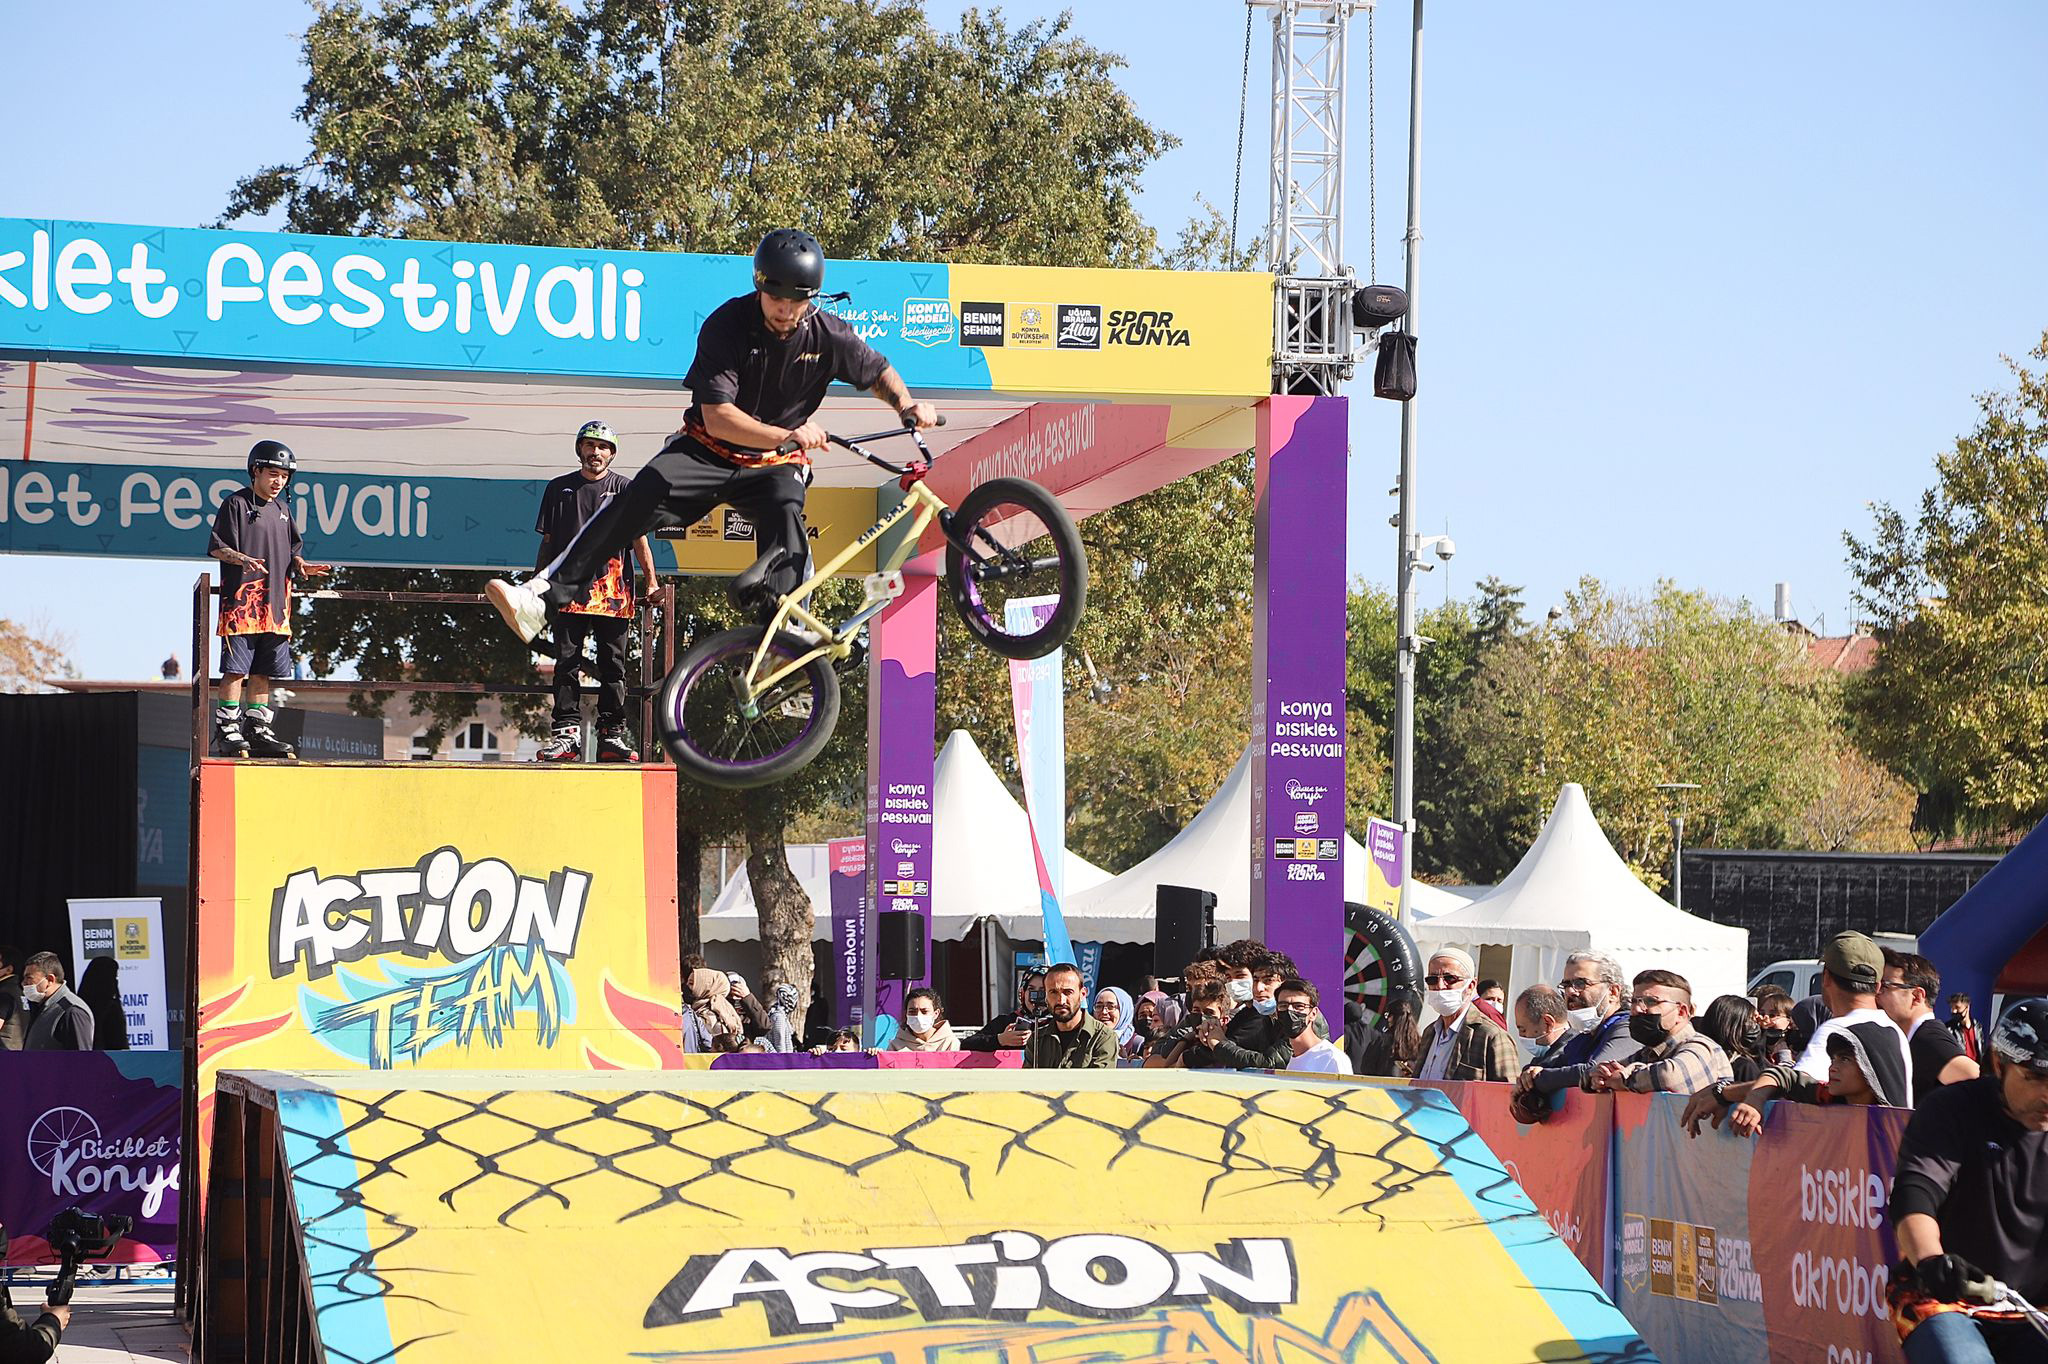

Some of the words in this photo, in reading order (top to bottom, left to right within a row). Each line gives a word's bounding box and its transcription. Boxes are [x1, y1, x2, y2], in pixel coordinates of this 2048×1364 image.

[206, 242, 644, 342] festivali
[907, 303, 949, 314] KONYA
[1107, 310, 1174, 330] SPOR
[1108, 325, 1190, 347] KONYA
[1044, 403, 1095, 469] festivali
[1280, 701, 1332, 720] konya
[1275, 721, 1337, 737] bisiklet
[1271, 742, 1342, 757] festivali
[889, 783, 926, 797] konya
[885, 797, 929, 809] bisiklet
[881, 812, 932, 824] festivali
[1366, 920, 1379, 933] 18
[1384, 939, 1393, 948] 4
[1391, 957, 1402, 972] 13
[309, 937, 561, 1069] TEAM
[1718, 1238, 1752, 1270] SPOR
[1719, 1263, 1763, 1303] KONYA
